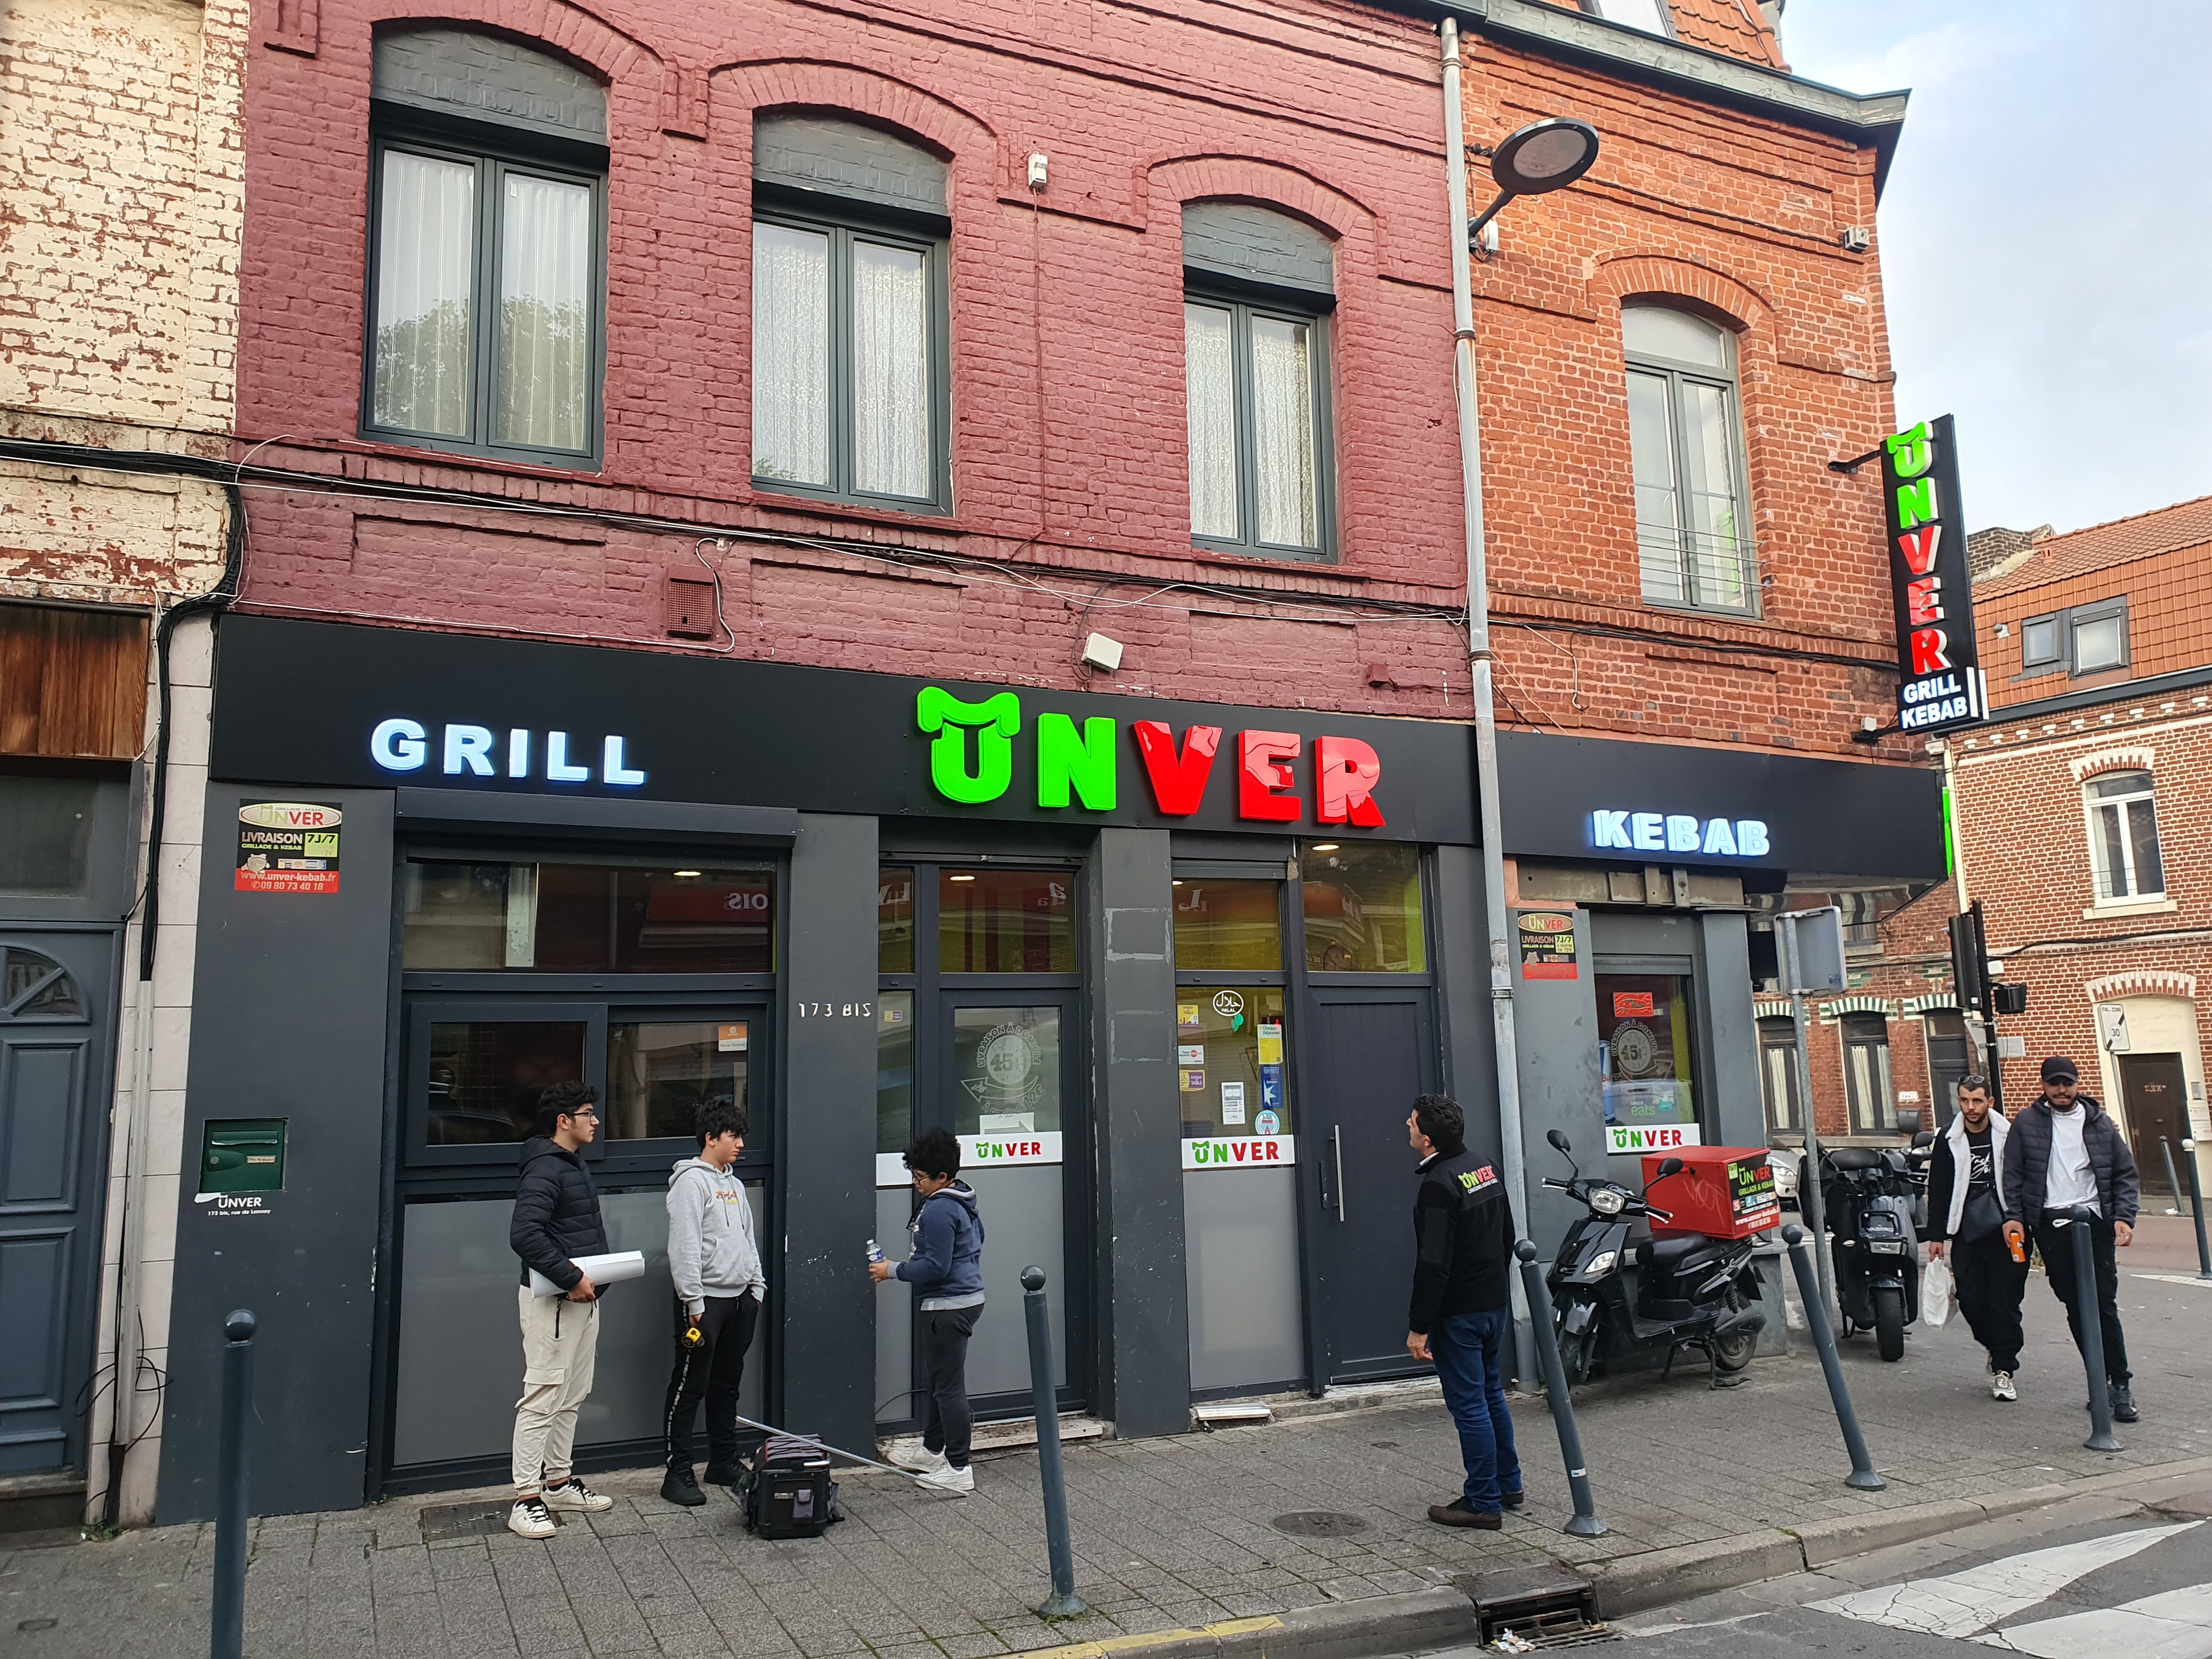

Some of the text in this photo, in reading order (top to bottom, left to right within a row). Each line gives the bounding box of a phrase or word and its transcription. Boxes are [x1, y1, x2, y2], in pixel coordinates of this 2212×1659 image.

[1903, 673, 1962, 704] GRILL
[1901, 696, 1968, 729] KEBAB
[370, 718, 646, 786] GRILL
[241, 831, 303, 844] LIVRAISON
[307, 834, 336, 844] 7J/7
[1593, 809, 1770, 856] KEBAB
[240, 871, 336, 882] www.unver-kebab.fr
[274, 882, 285, 890] 80
[300, 882, 311, 890] 40
[1521, 935, 1554, 944] LIVRAISON
[1216, 993, 1241, 1007] حلال
[798, 1002, 871, 1018] 173 BIS
[2111, 1028, 2120, 1037] 30
[977, 1024, 1006, 1068] LIVRAISON
[1015, 1025, 1041, 1065] DOMICILE
[990, 1052, 1014, 1072] 45
[1630, 1104, 1656, 1116] eats
[1738, 1184, 1758, 1196] GRILLADE
[1761, 1180, 1775, 1189] KEBAB
